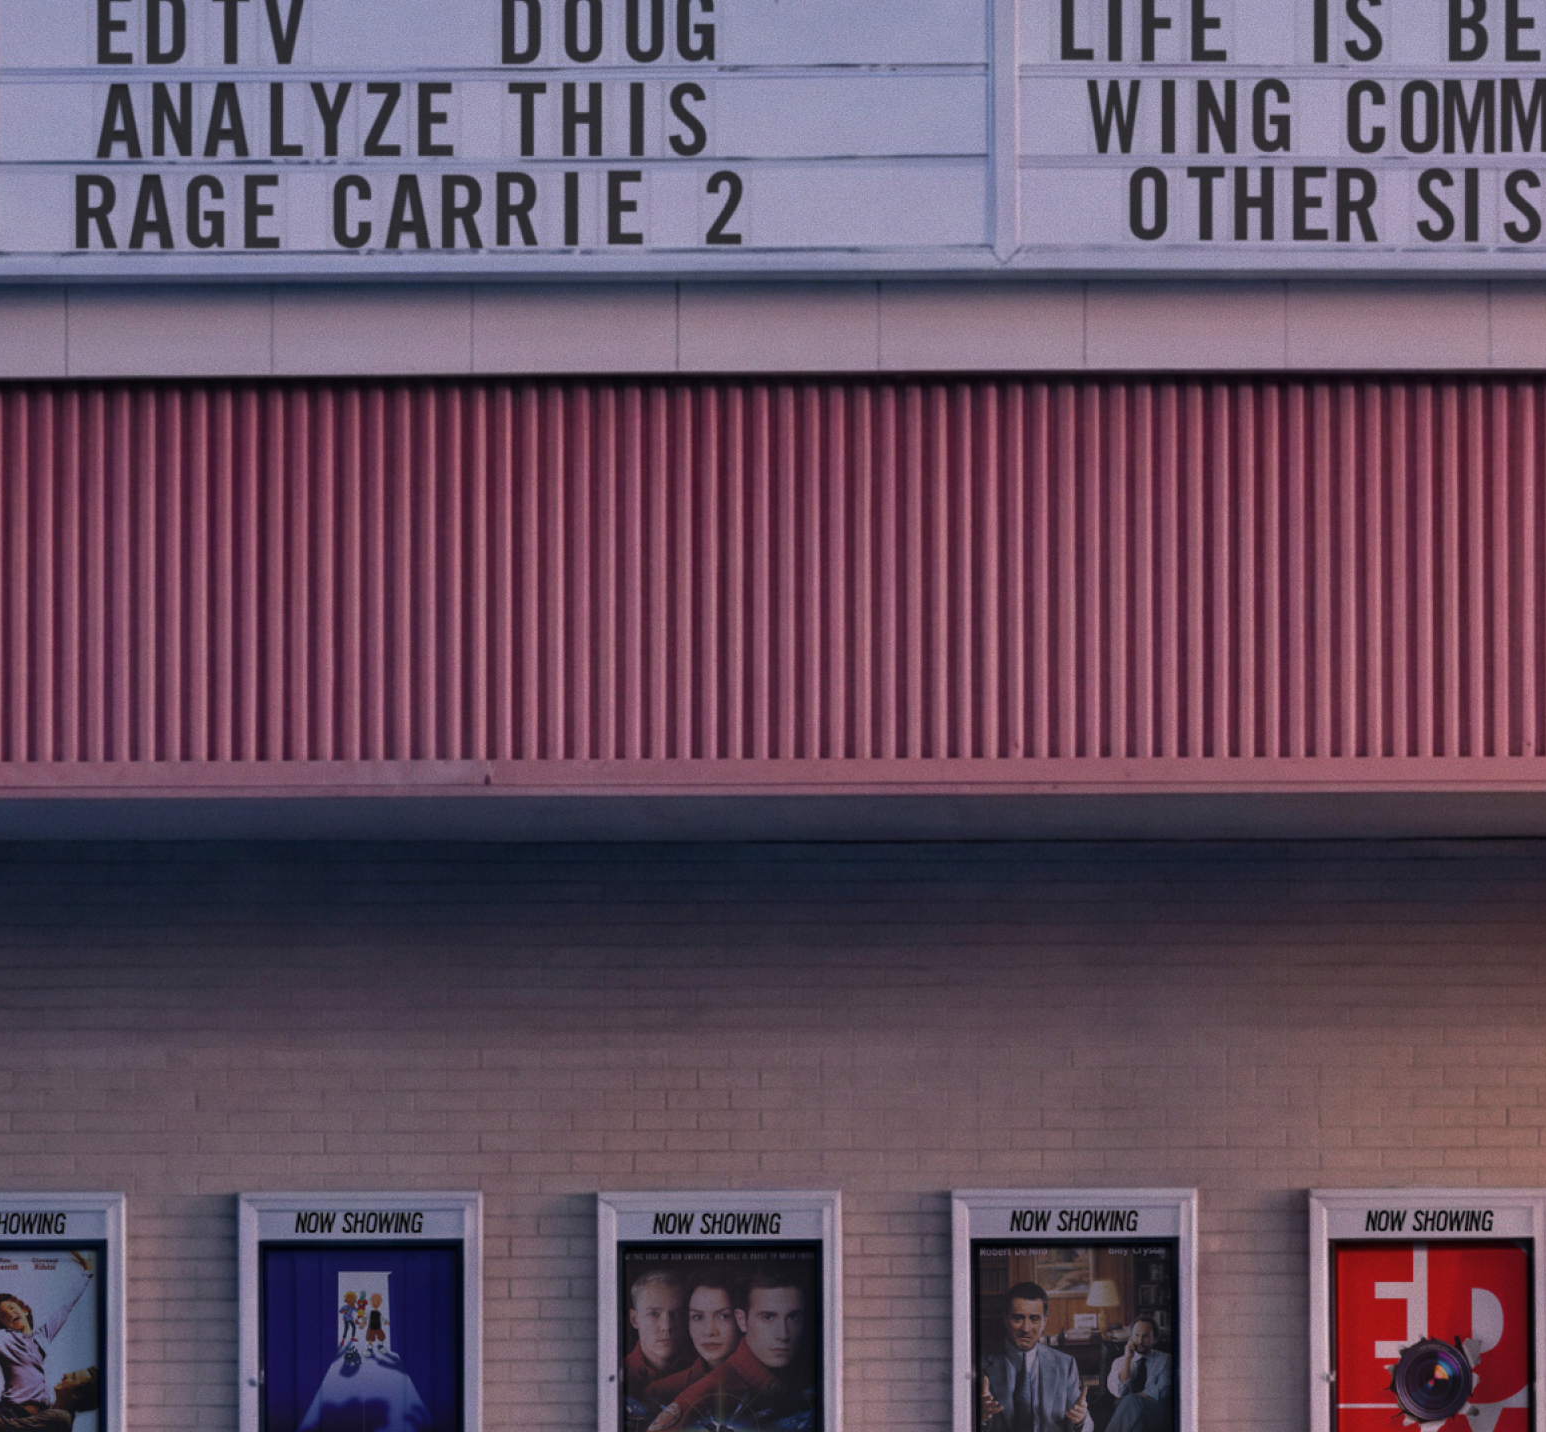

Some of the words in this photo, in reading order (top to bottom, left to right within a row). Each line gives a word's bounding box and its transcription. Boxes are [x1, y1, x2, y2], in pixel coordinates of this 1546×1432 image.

[97, 0, 303, 64] EDTV
[501, 0, 715, 64] DOUG
[1060, 0, 1227, 62] LIFE
[1313, 0, 1383, 63] IS
[96, 82, 454, 159] ANALYZE
[508, 81, 707, 157] THIS
[1086, 79, 1291, 153] WING
[74, 174, 280, 249] RAGE
[332, 170, 644, 249] CARRIE
[705, 170, 744, 245] 2
[1129, 166, 1377, 242] OTHER
[294, 1211, 337, 1233] NOW
[342, 1211, 424, 1233] SHOWING
[652, 1213, 695, 1234] NOW
[700, 1213, 782, 1234] SHOWING
[979, 1246, 1012, 1256] Robert
[1009, 1210, 1052, 1231] NOW
[1056, 1210, 1139, 1231] SHOWING
[1365, 1210, 1407, 1231] NOW
[1412, 1210, 1494, 1231] SHOWING
